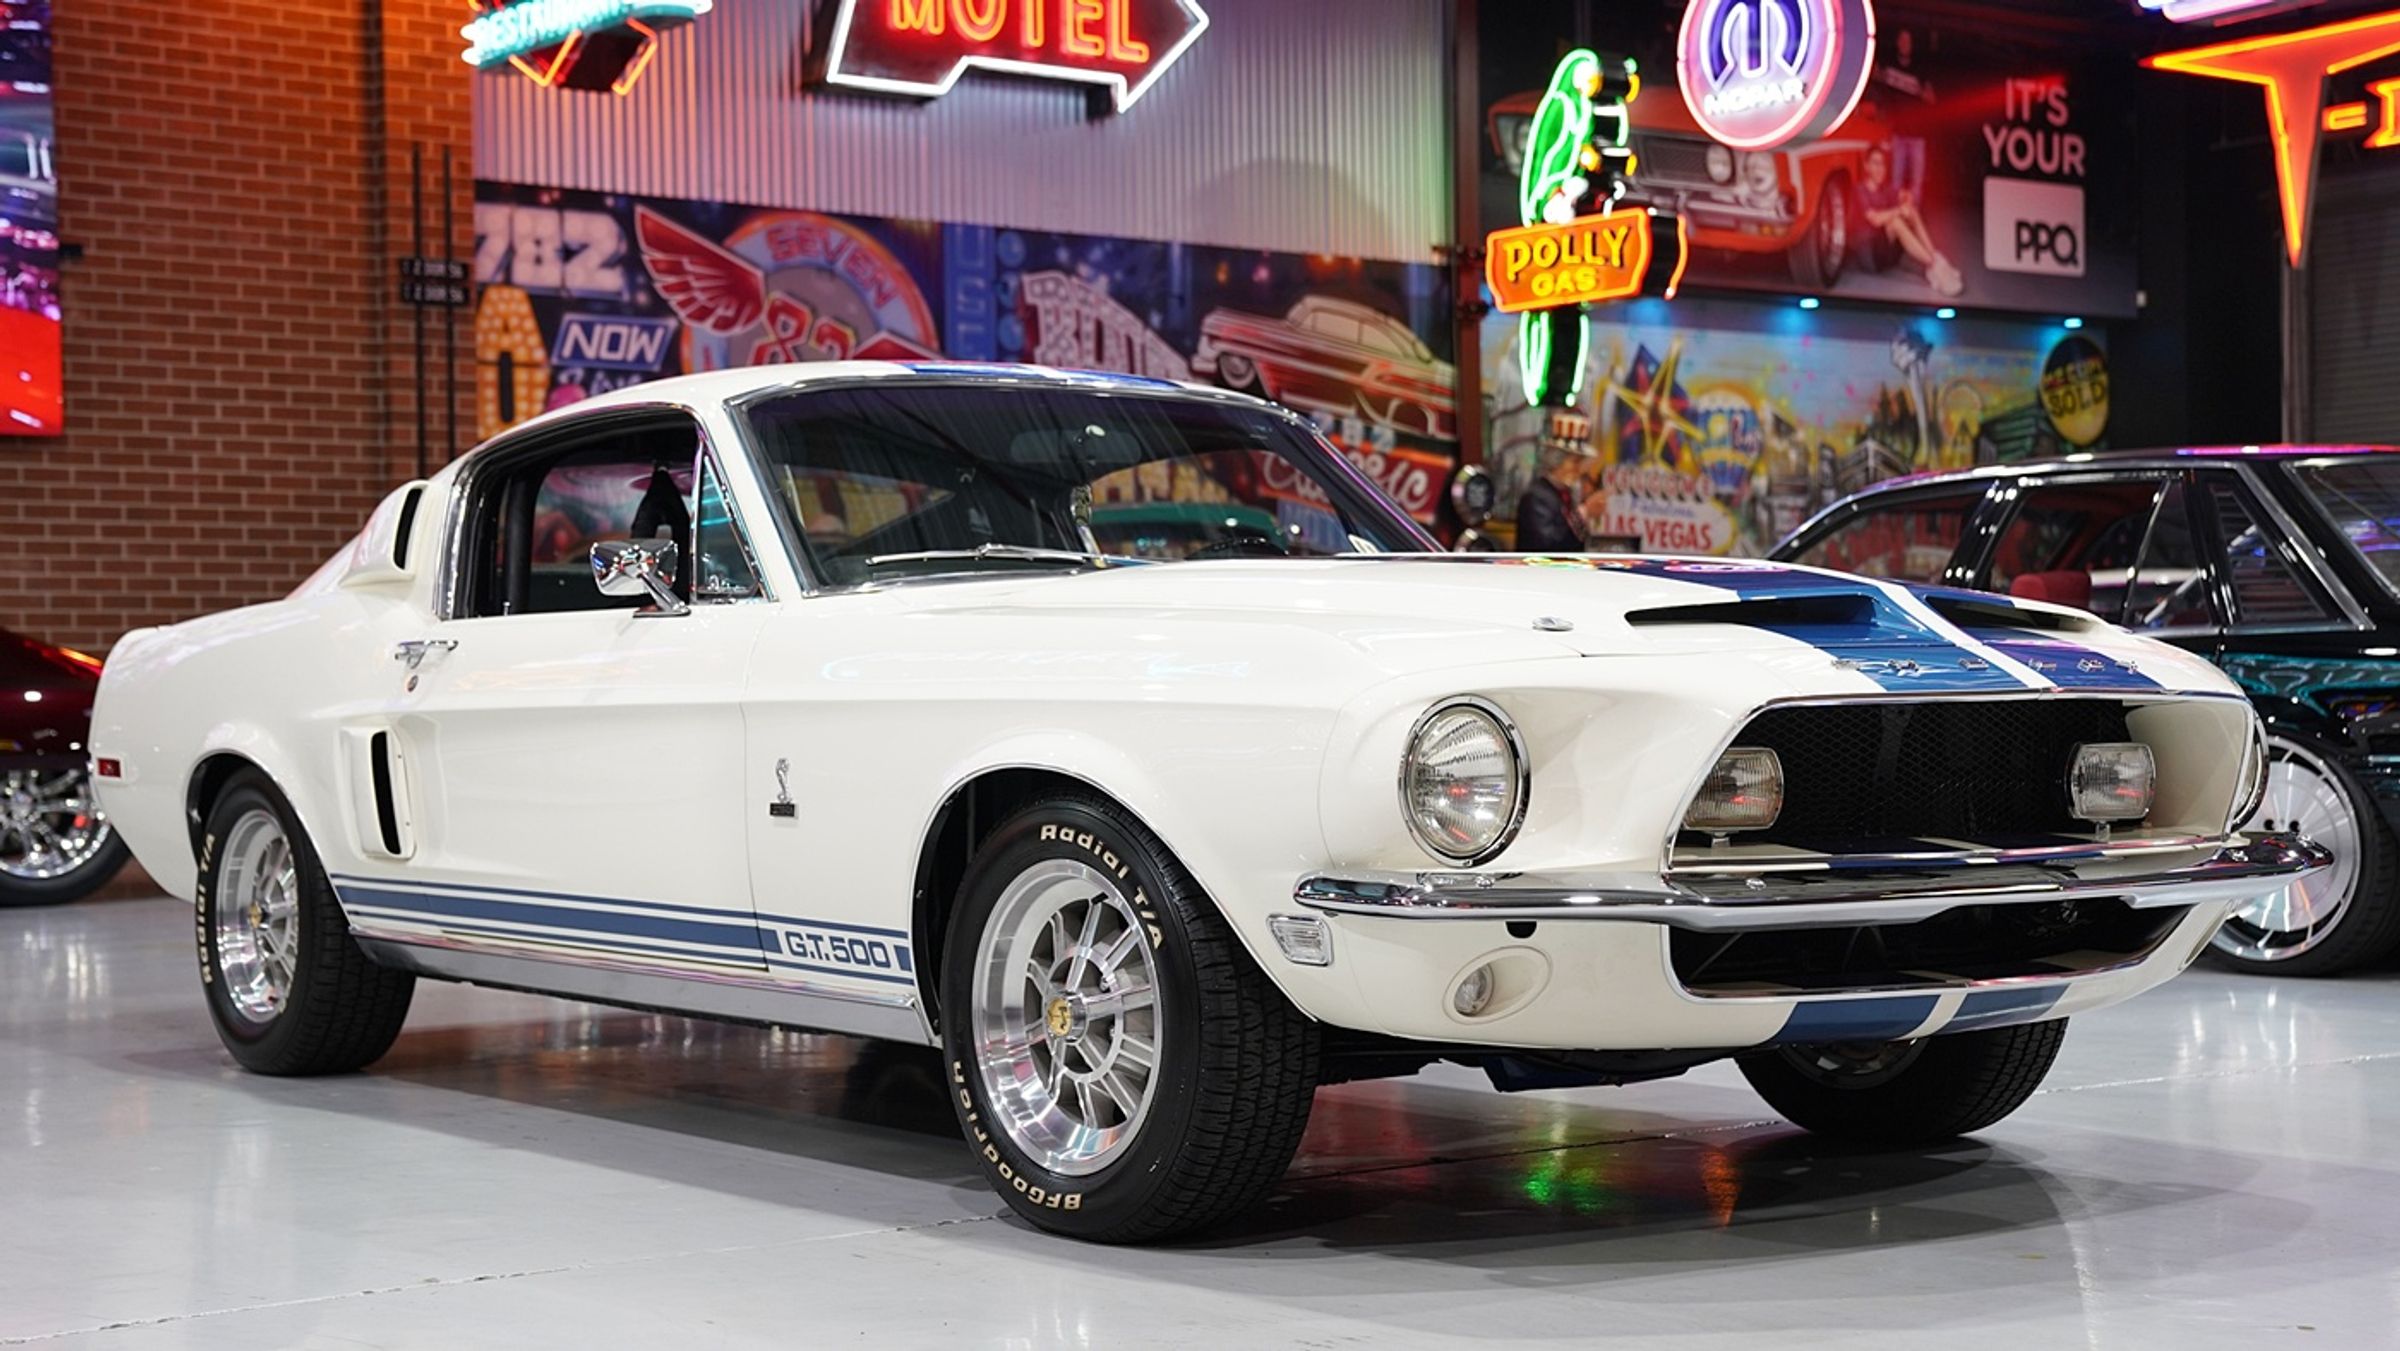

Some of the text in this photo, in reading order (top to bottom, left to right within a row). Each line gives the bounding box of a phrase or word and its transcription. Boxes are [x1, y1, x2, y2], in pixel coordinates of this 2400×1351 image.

[886, 0, 1150, 63] MOTEL
[1703, 78, 1811, 116] MOPAR
[2005, 77, 2069, 127] IT'S
[1982, 123, 2086, 177] YOUR
[475, 203, 624, 294] 782
[767, 224, 899, 310] SEVEN
[1504, 225, 1629, 282] POLLY
[2015, 219, 2080, 269] PPQ
[1531, 266, 1597, 297] GAS
[560, 320, 666, 364] NOW
[1643, 518, 1713, 550] VEGAS
[1039, 823, 1165, 951] Radial T/A
[784, 931, 891, 968] G.T.500
[951, 1060, 1083, 1211] BFGoodrich
